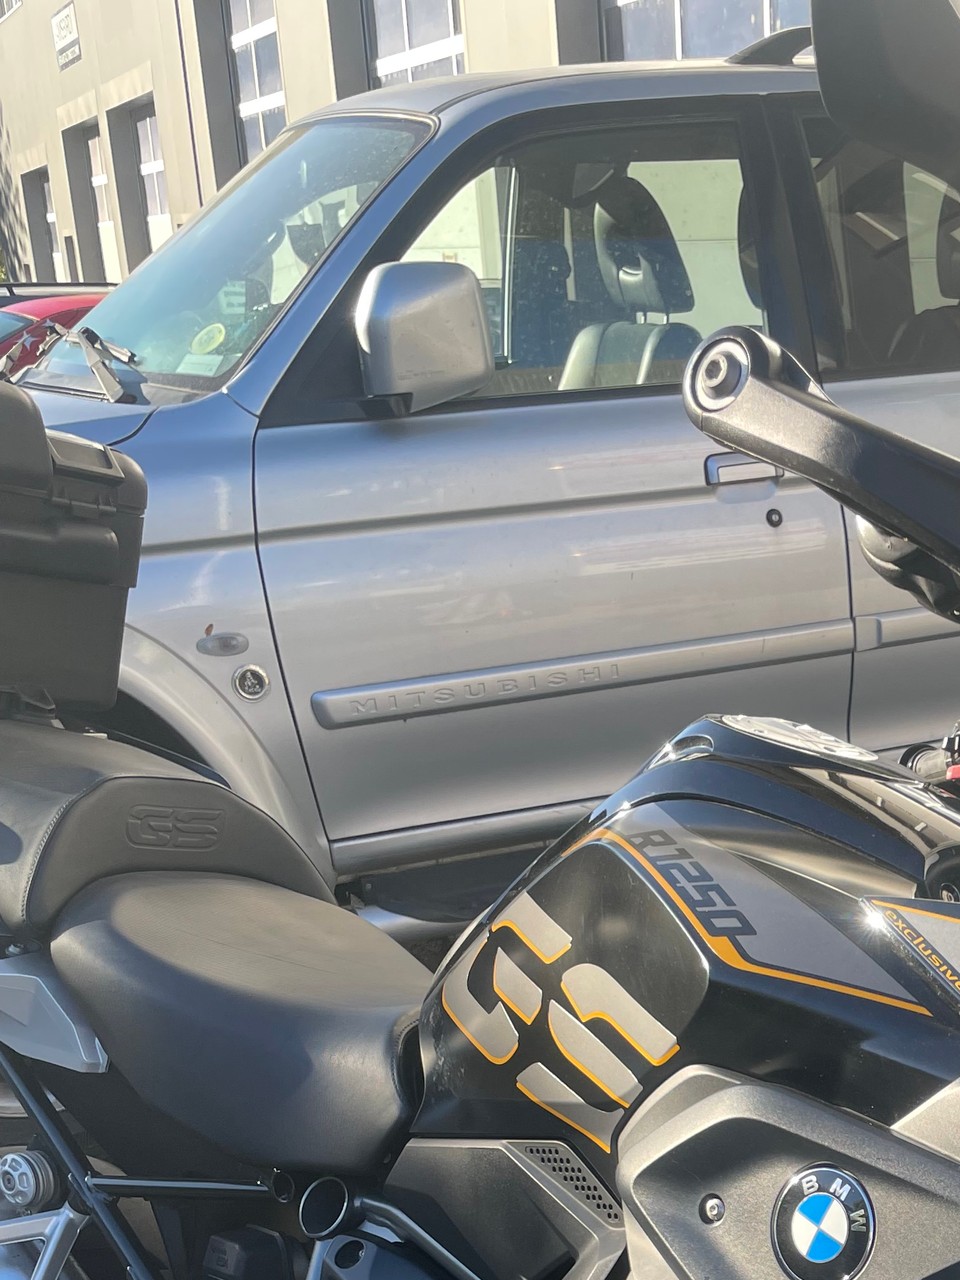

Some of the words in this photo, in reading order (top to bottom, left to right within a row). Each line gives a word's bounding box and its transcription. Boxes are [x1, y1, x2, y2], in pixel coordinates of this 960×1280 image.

[350, 663, 622, 716] MITSUBISHI
[126, 804, 224, 852] GS
[442, 891, 681, 1154] GS
[801, 1174, 867, 1232] BMW
